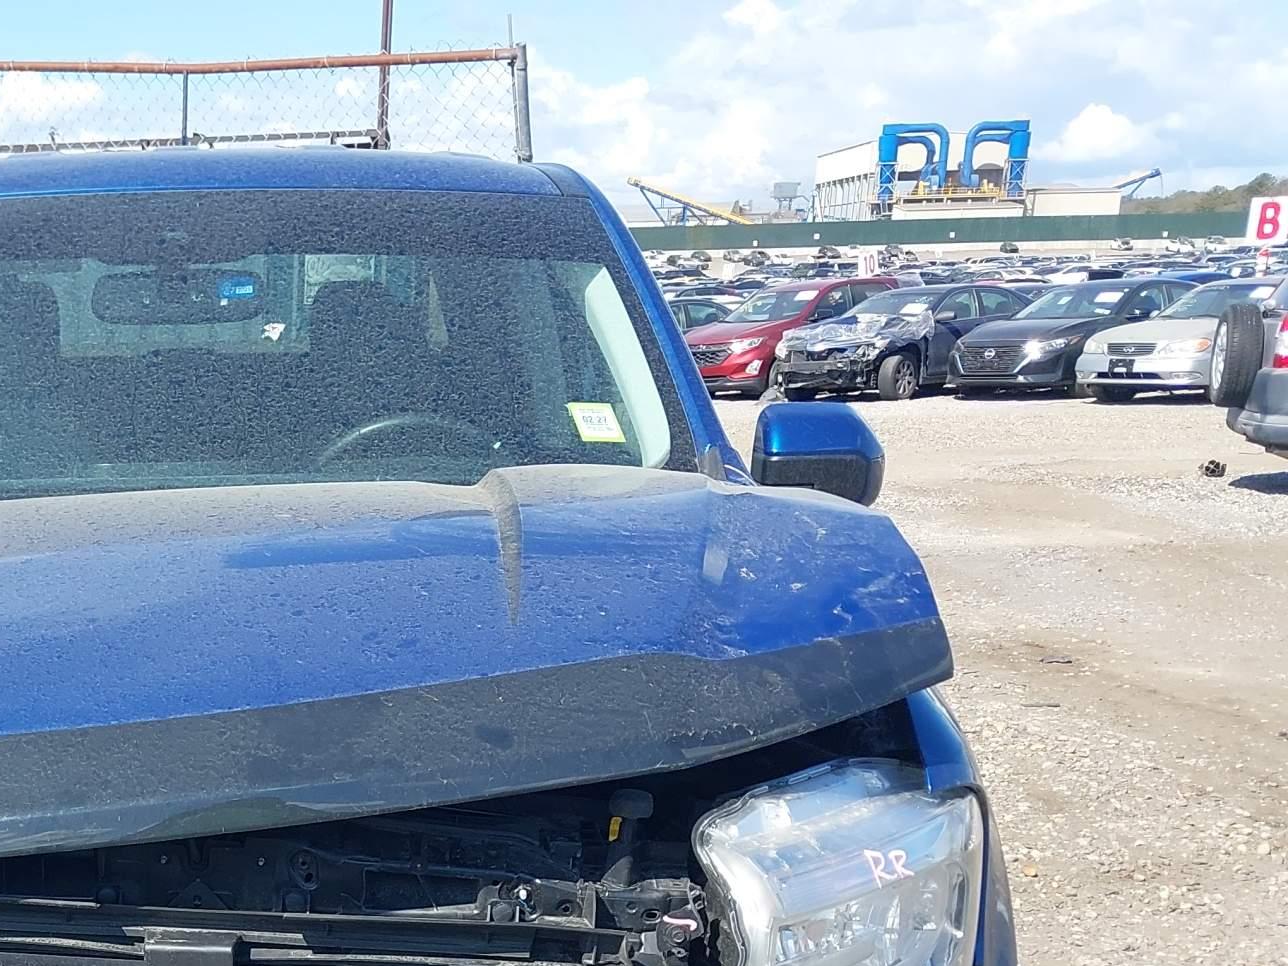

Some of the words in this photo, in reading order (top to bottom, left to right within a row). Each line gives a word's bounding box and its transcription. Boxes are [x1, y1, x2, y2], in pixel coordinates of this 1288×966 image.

[1256, 201, 1281, 240] B
[863, 254, 876, 275] 10
[863, 849, 915, 889] RR
